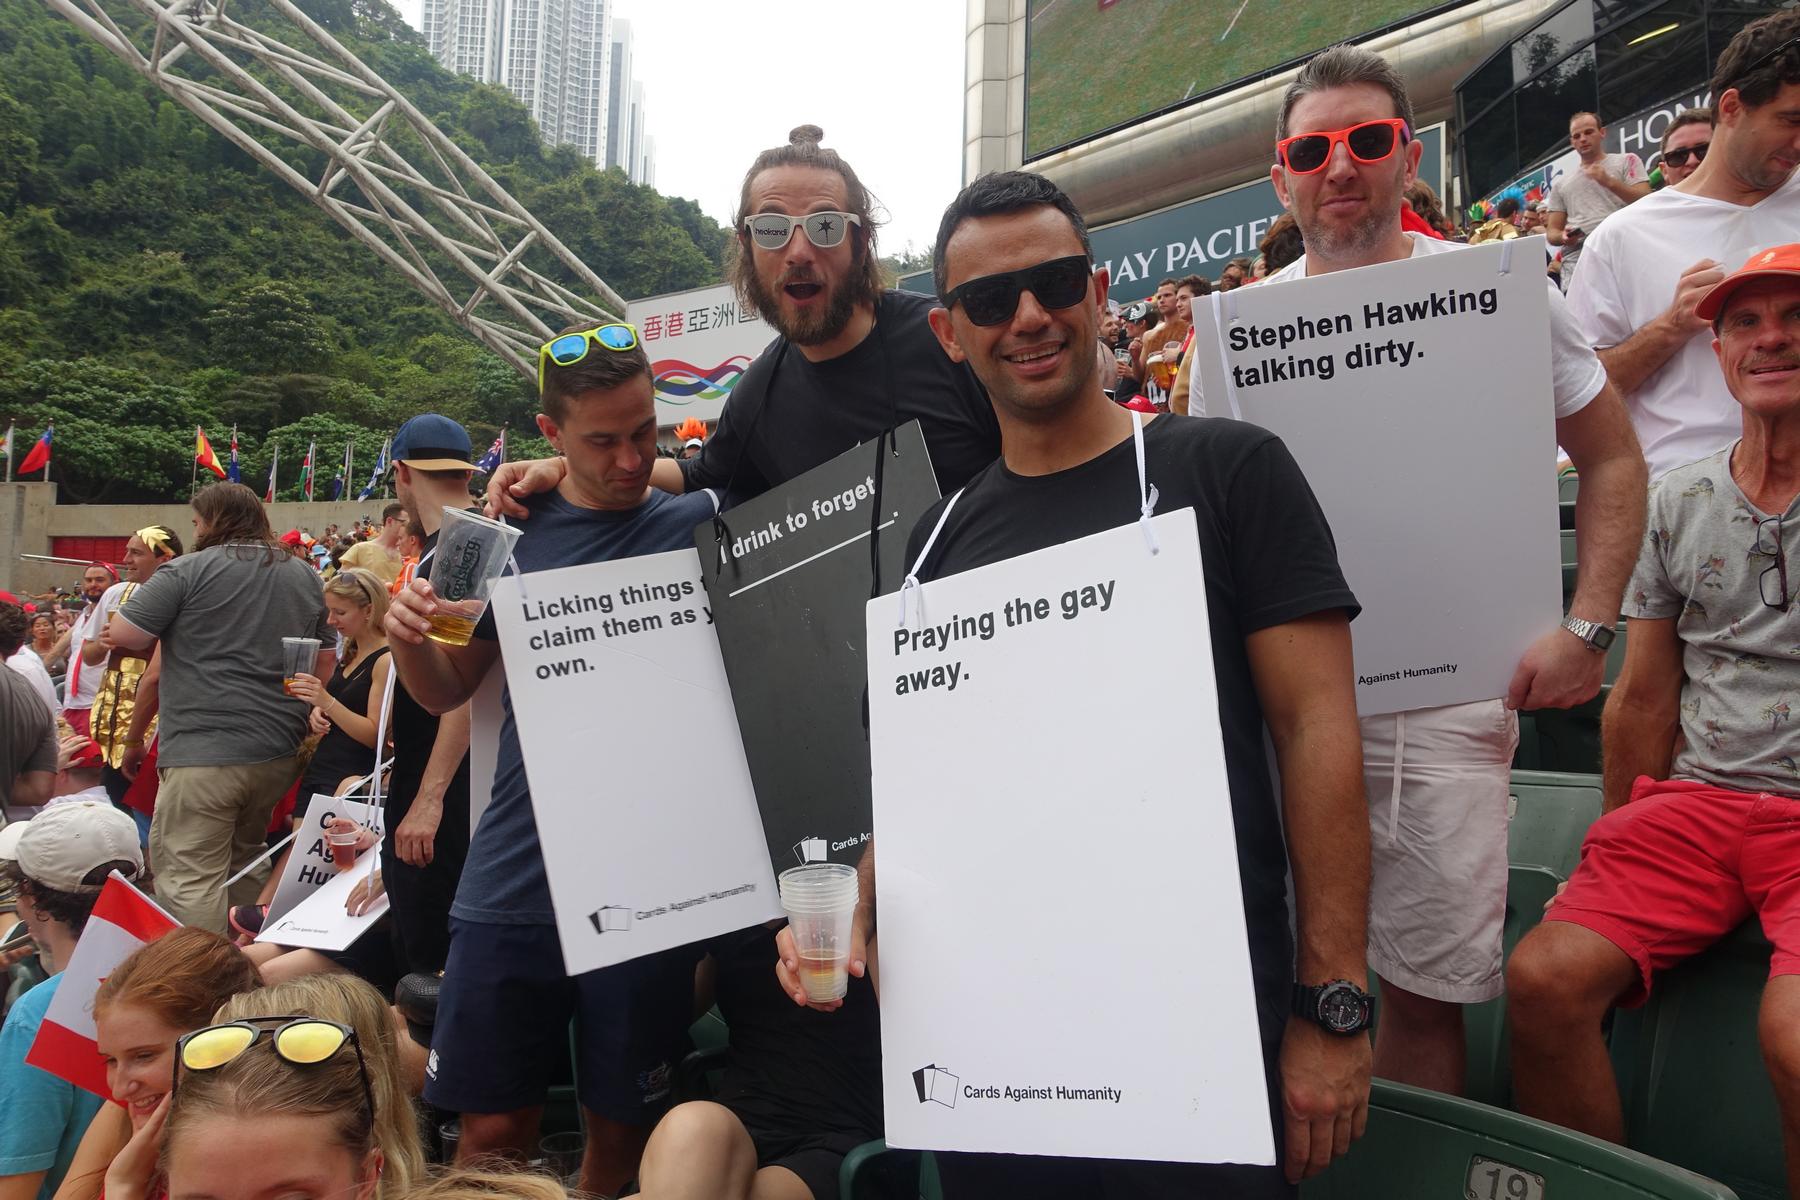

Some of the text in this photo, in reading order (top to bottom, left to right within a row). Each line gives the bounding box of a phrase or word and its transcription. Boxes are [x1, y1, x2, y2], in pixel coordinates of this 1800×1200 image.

[1229, 288, 1498, 352] Stephen Hawking
[1232, 339, 1424, 389] talking dirty.
[720, 475, 876, 565] I drink to forget
[444, 538, 481, 601] Carlsberg
[522, 592, 614, 622] Licking
[619, 580, 695, 605] things
[894, 579, 1115, 656] Praying the gay
[529, 626, 596, 651] claim
[602, 614, 663, 638] them
[670, 608, 697, 626] as
[536, 657, 595, 680] own.
[895, 661, 970, 695] away.
[1358, 664, 1458, 686] Against Humanity
[831, 836, 858, 851] Cards
[963, 1085, 1122, 1103] Cards Against Humanity
[1486, 1168, 1528, 1200] 19
